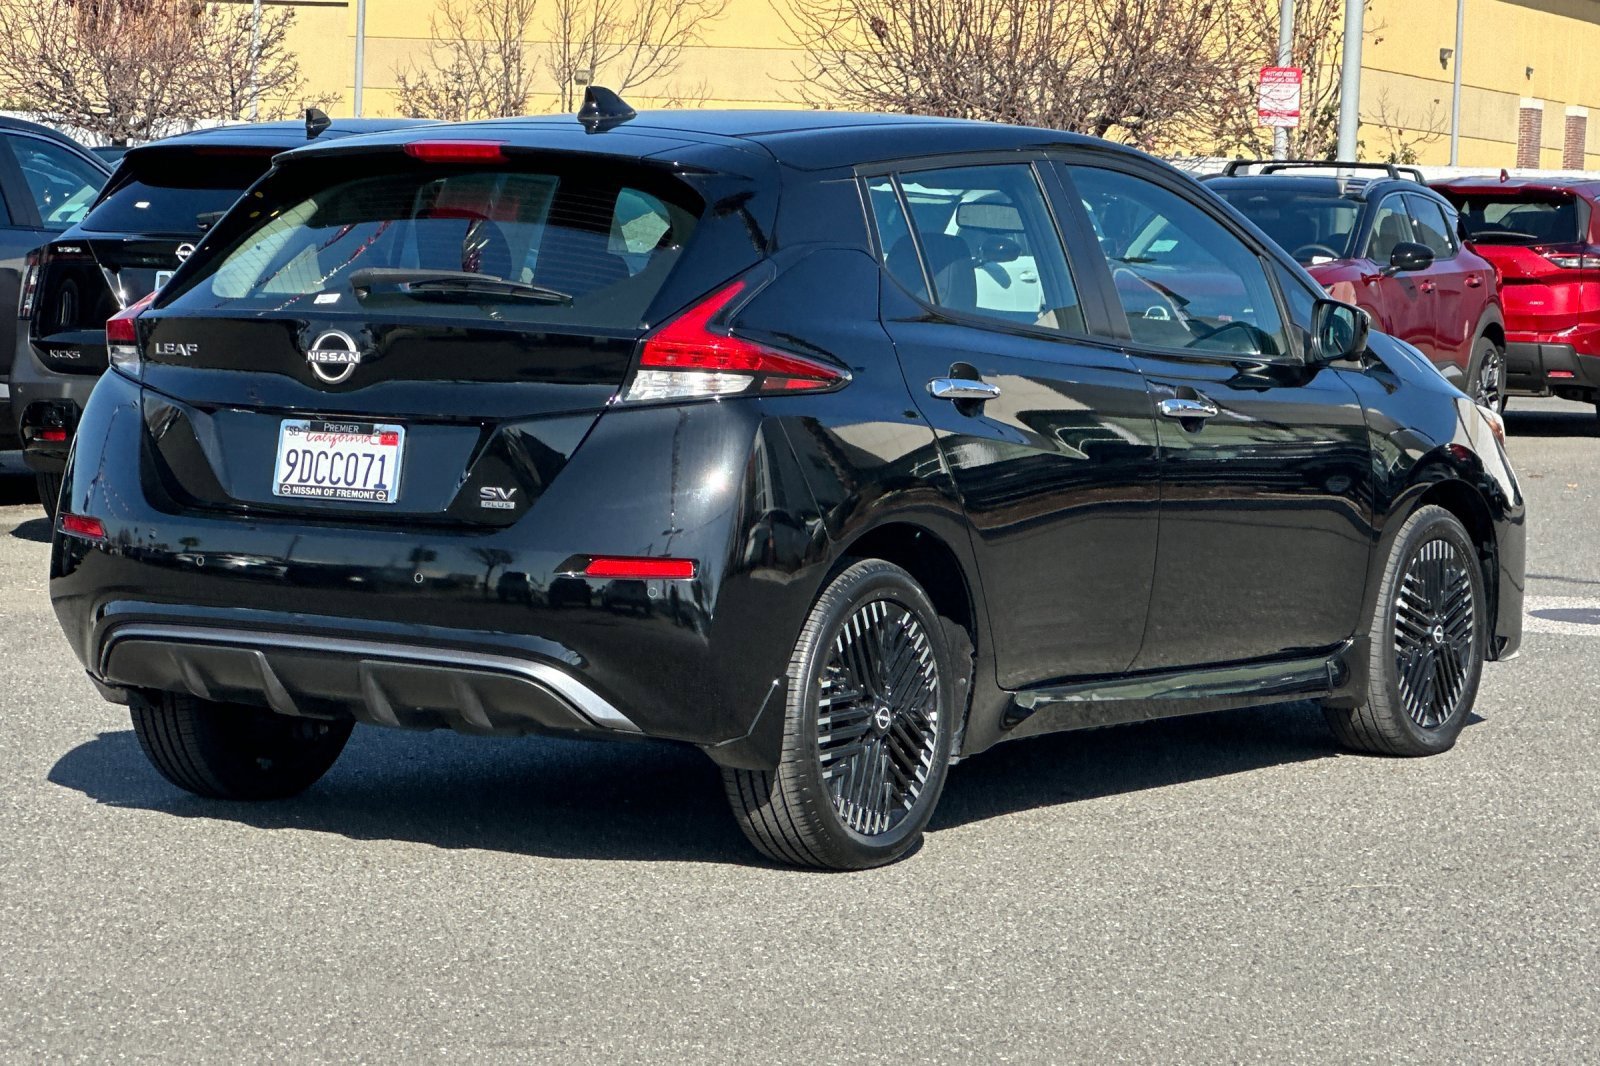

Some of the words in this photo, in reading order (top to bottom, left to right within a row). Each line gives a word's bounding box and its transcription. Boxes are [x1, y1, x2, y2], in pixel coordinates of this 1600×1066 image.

[50, 350, 80, 359] KICKS
[155, 343, 198, 356] LEAF
[307, 351, 359, 362] NISSAN
[324, 422, 359, 433] PREMIER
[306, 431, 373, 448] California
[283, 449, 387, 489] 9DCC071
[292, 487, 322, 496] NISSAN
[323, 488, 333, 496] OF
[336, 489, 375, 499] FREMONT
[480, 486, 517, 500] SV
